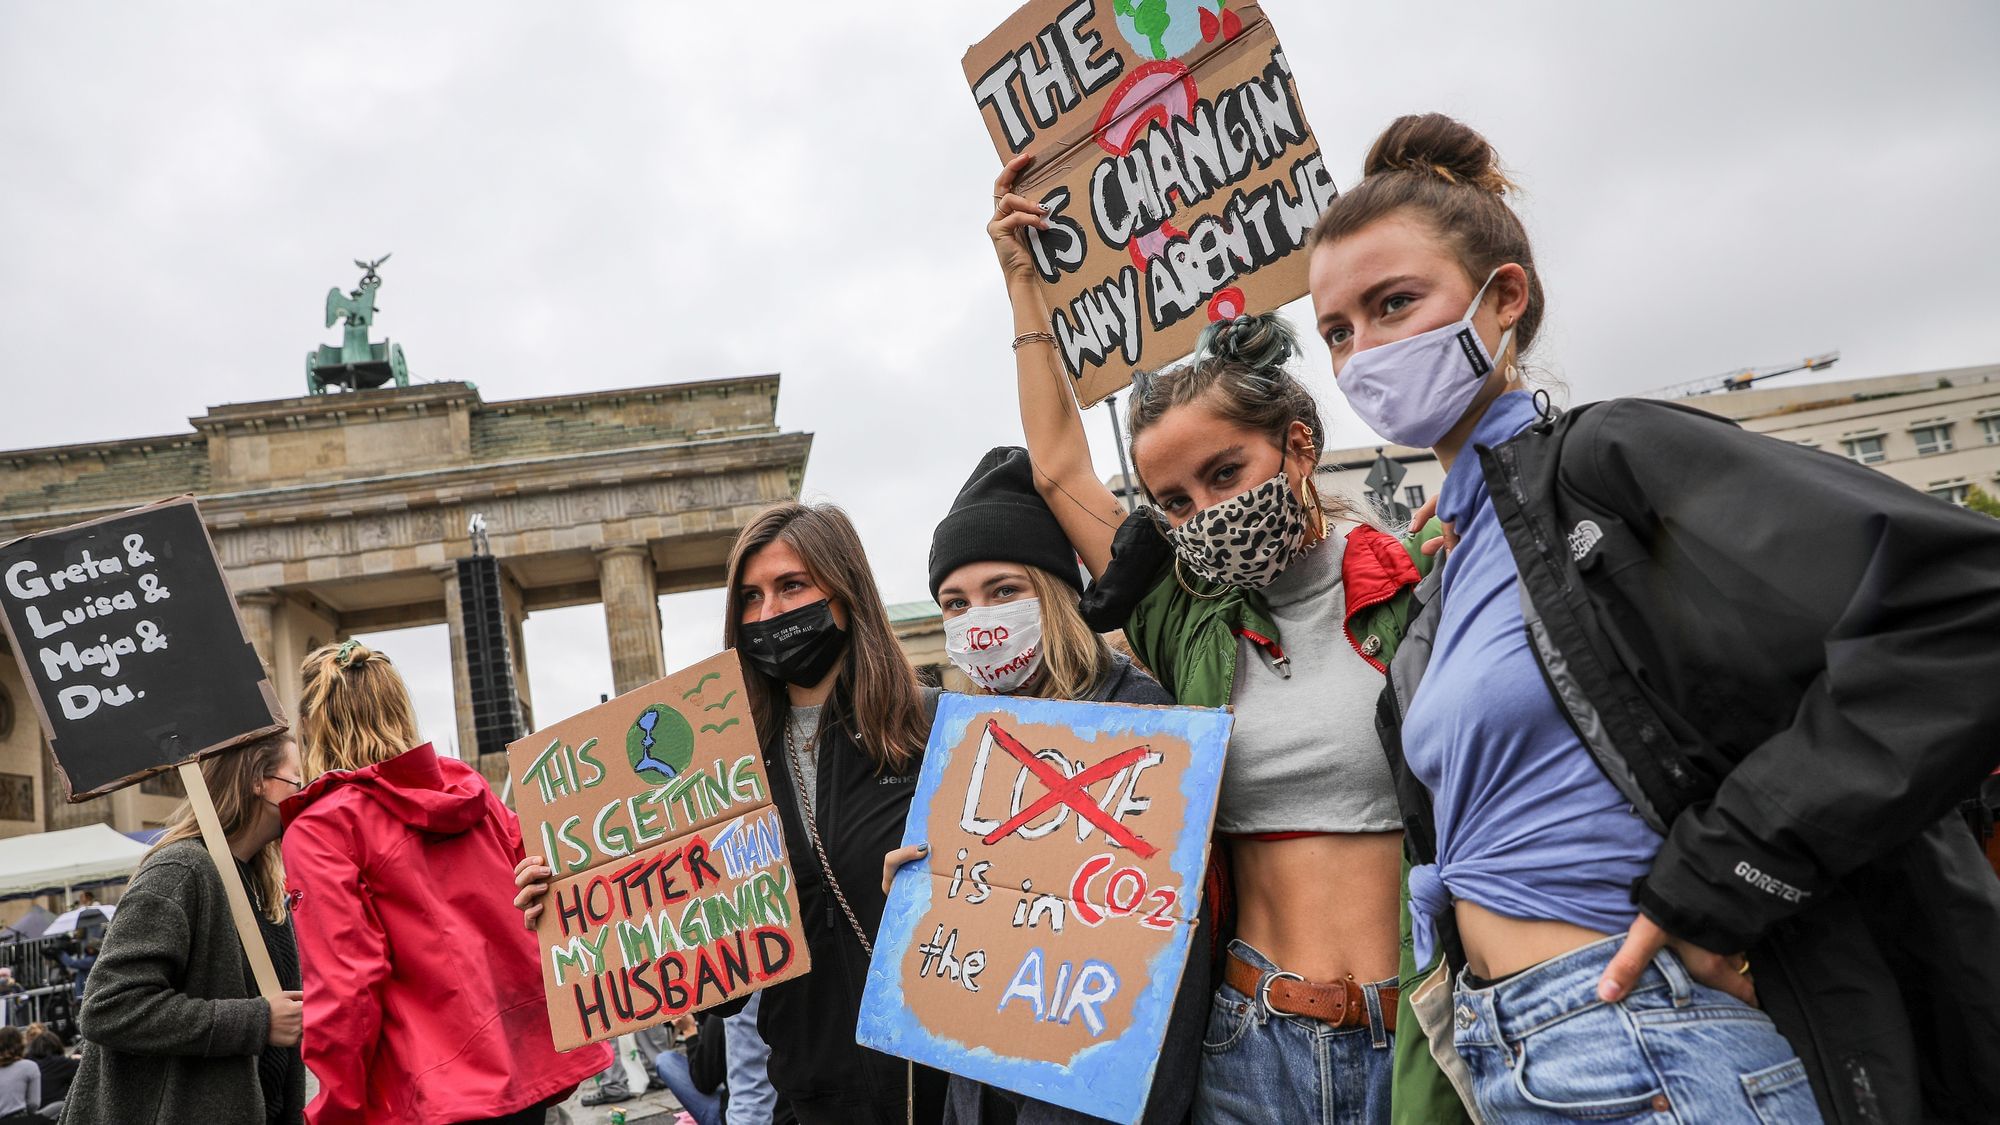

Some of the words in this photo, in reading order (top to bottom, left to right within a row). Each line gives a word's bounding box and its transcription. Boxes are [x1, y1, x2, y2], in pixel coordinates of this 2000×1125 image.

[971, 0, 1124, 153] THE
[1025, 187, 1086, 283] IS
[1052, 265, 1142, 378] WHY
[1270, 150, 1340, 250] WE
[5, 550, 122, 599] Greta
[123, 534, 155, 567] &
[25, 590, 137, 639] Luisa
[138, 573, 170, 603] &
[39, 634, 137, 681] Maja
[136, 620, 168, 653] &
[58, 684, 145, 720] Du.
[521, 737, 606, 804] THIS
[540, 815, 592, 876] IS
[592, 755, 766, 857] GETTING
[960, 721, 1164, 847] LOVE
[551, 925, 608, 986] MY
[616, 865, 791, 970] IMAGINARY
[555, 834, 720, 937] HOTTER
[710, 811, 785, 879] THAN
[948, 848, 993, 903] is
[1012, 878, 1065, 933] in
[573, 926, 794, 1040] HUSBAND
[918, 923, 986, 992] the
[997, 947, 1120, 1036] AIR
